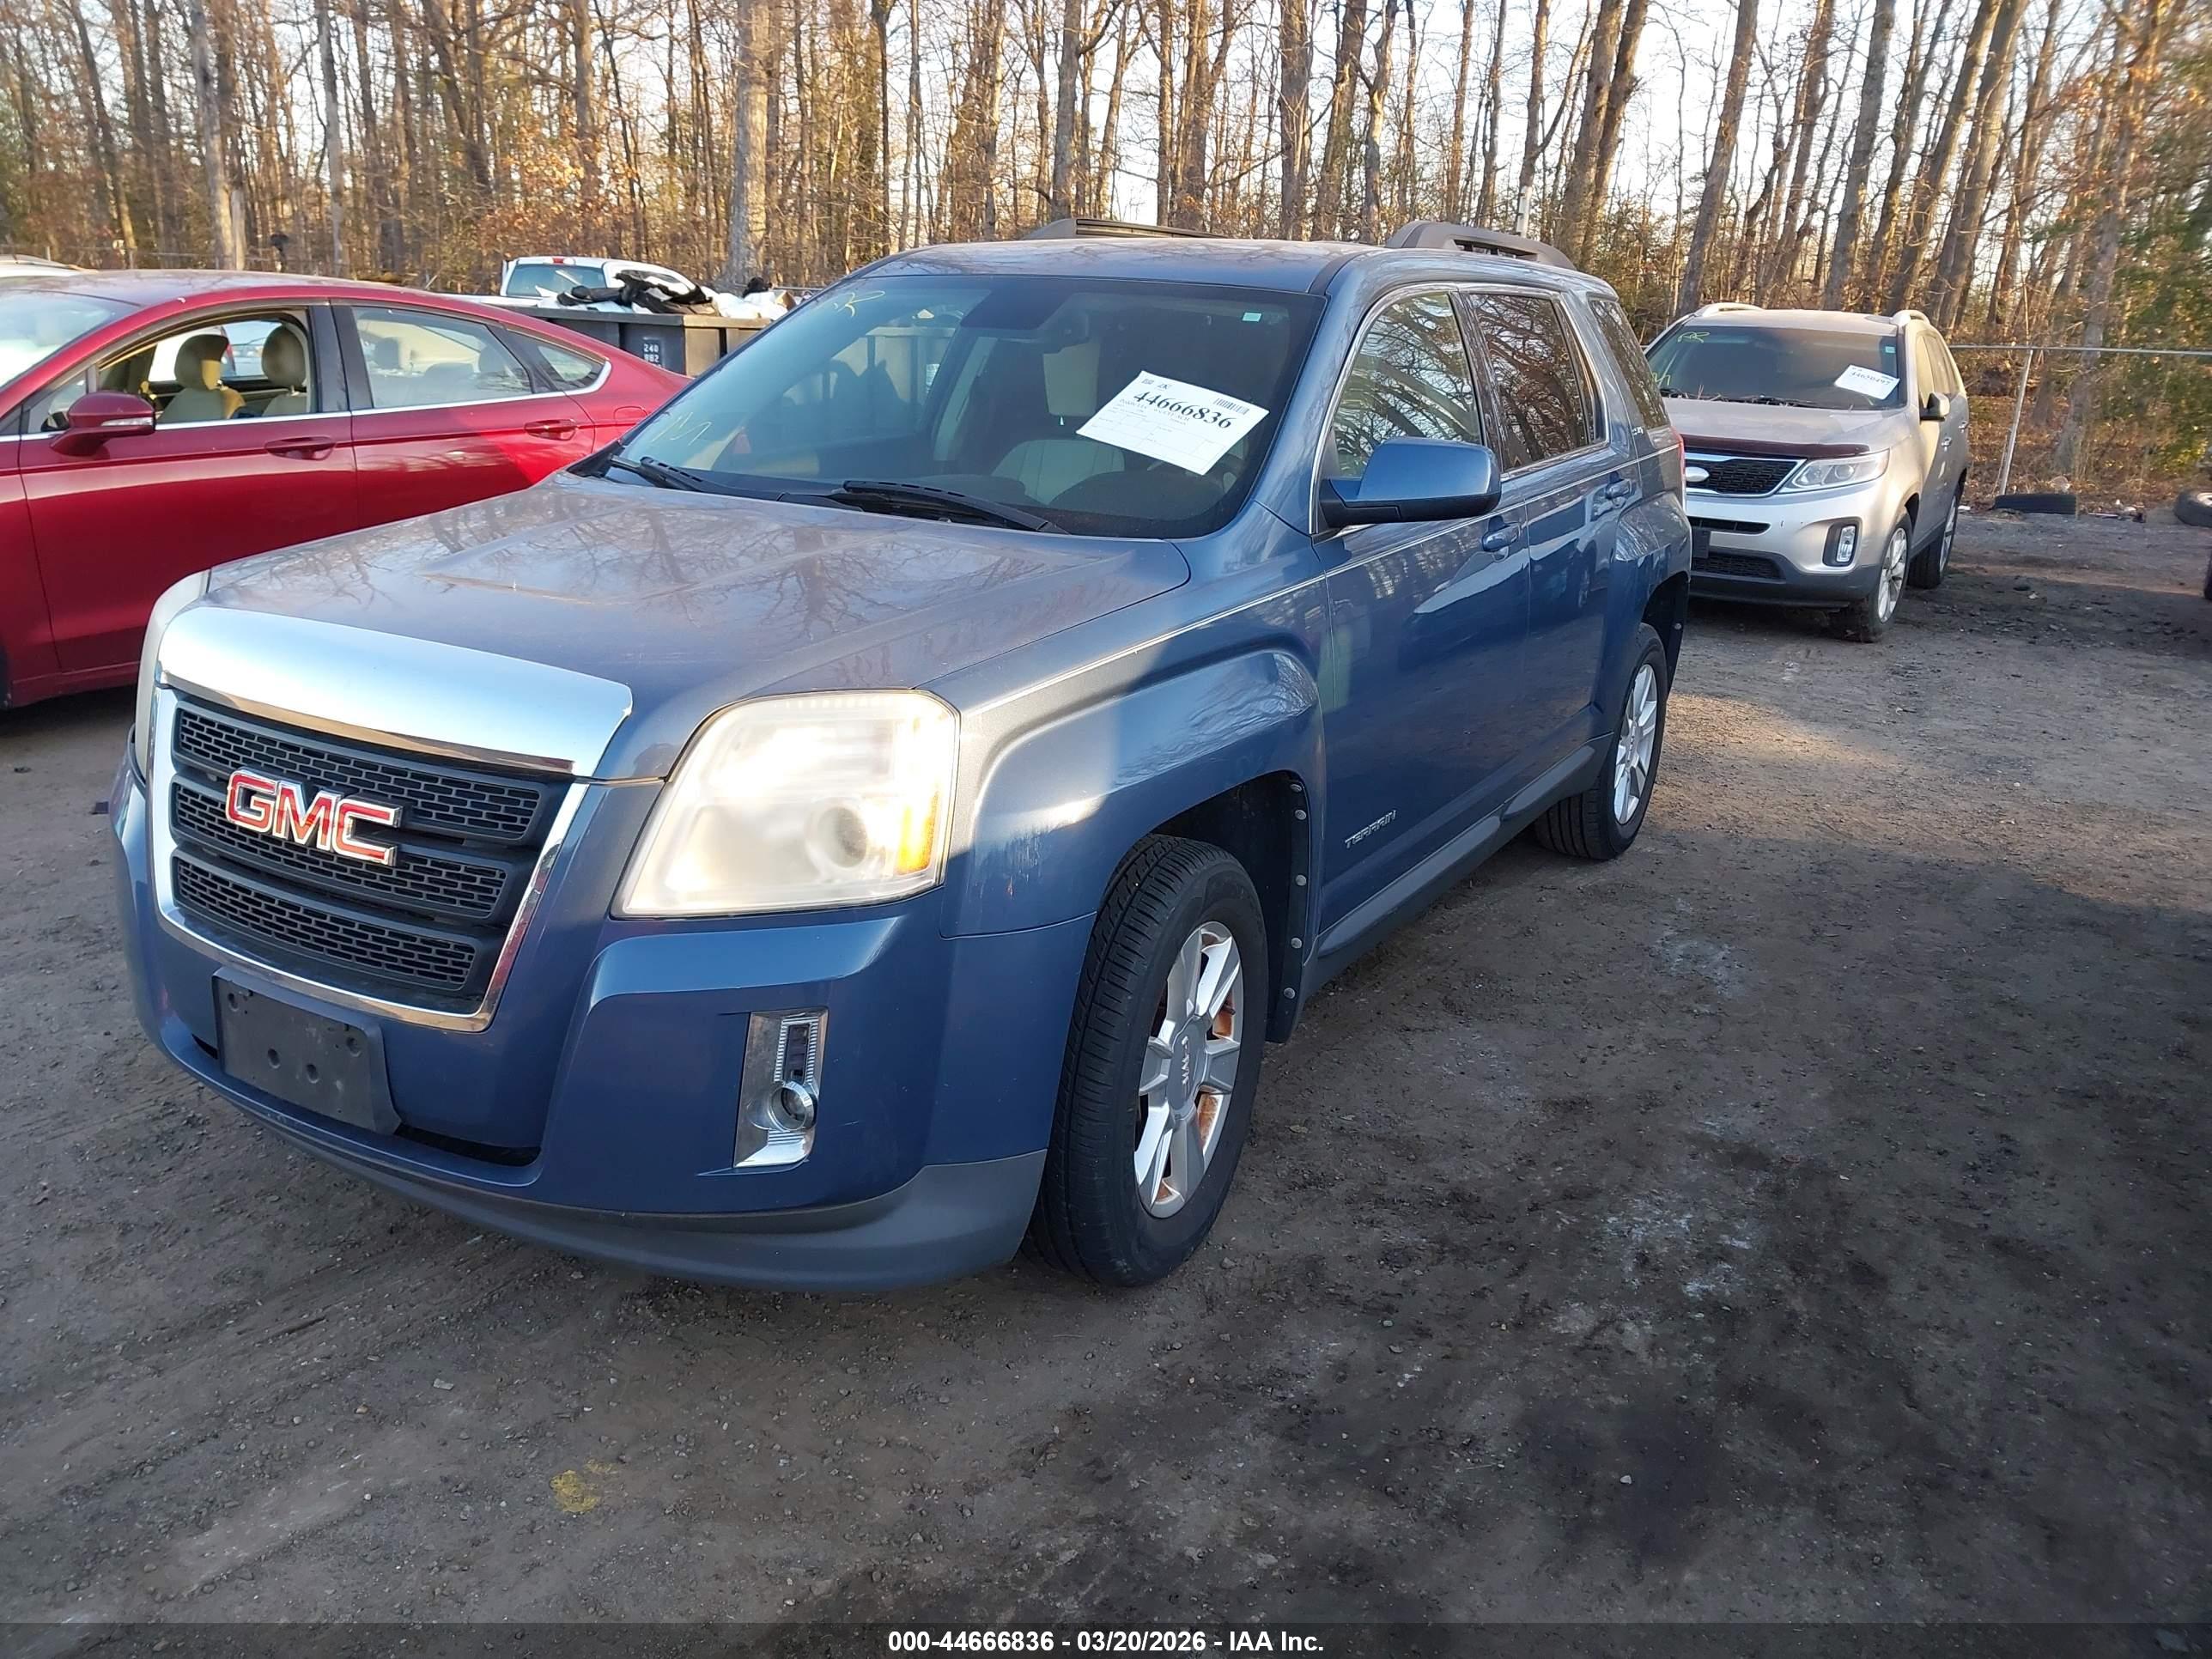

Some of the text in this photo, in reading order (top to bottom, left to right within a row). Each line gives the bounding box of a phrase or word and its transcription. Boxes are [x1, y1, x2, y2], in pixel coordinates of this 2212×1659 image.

[1133, 391, 1237, 428] 44666836
[226, 769, 402, 866] GMC
[1344, 810, 1397, 848] TERRAIN
